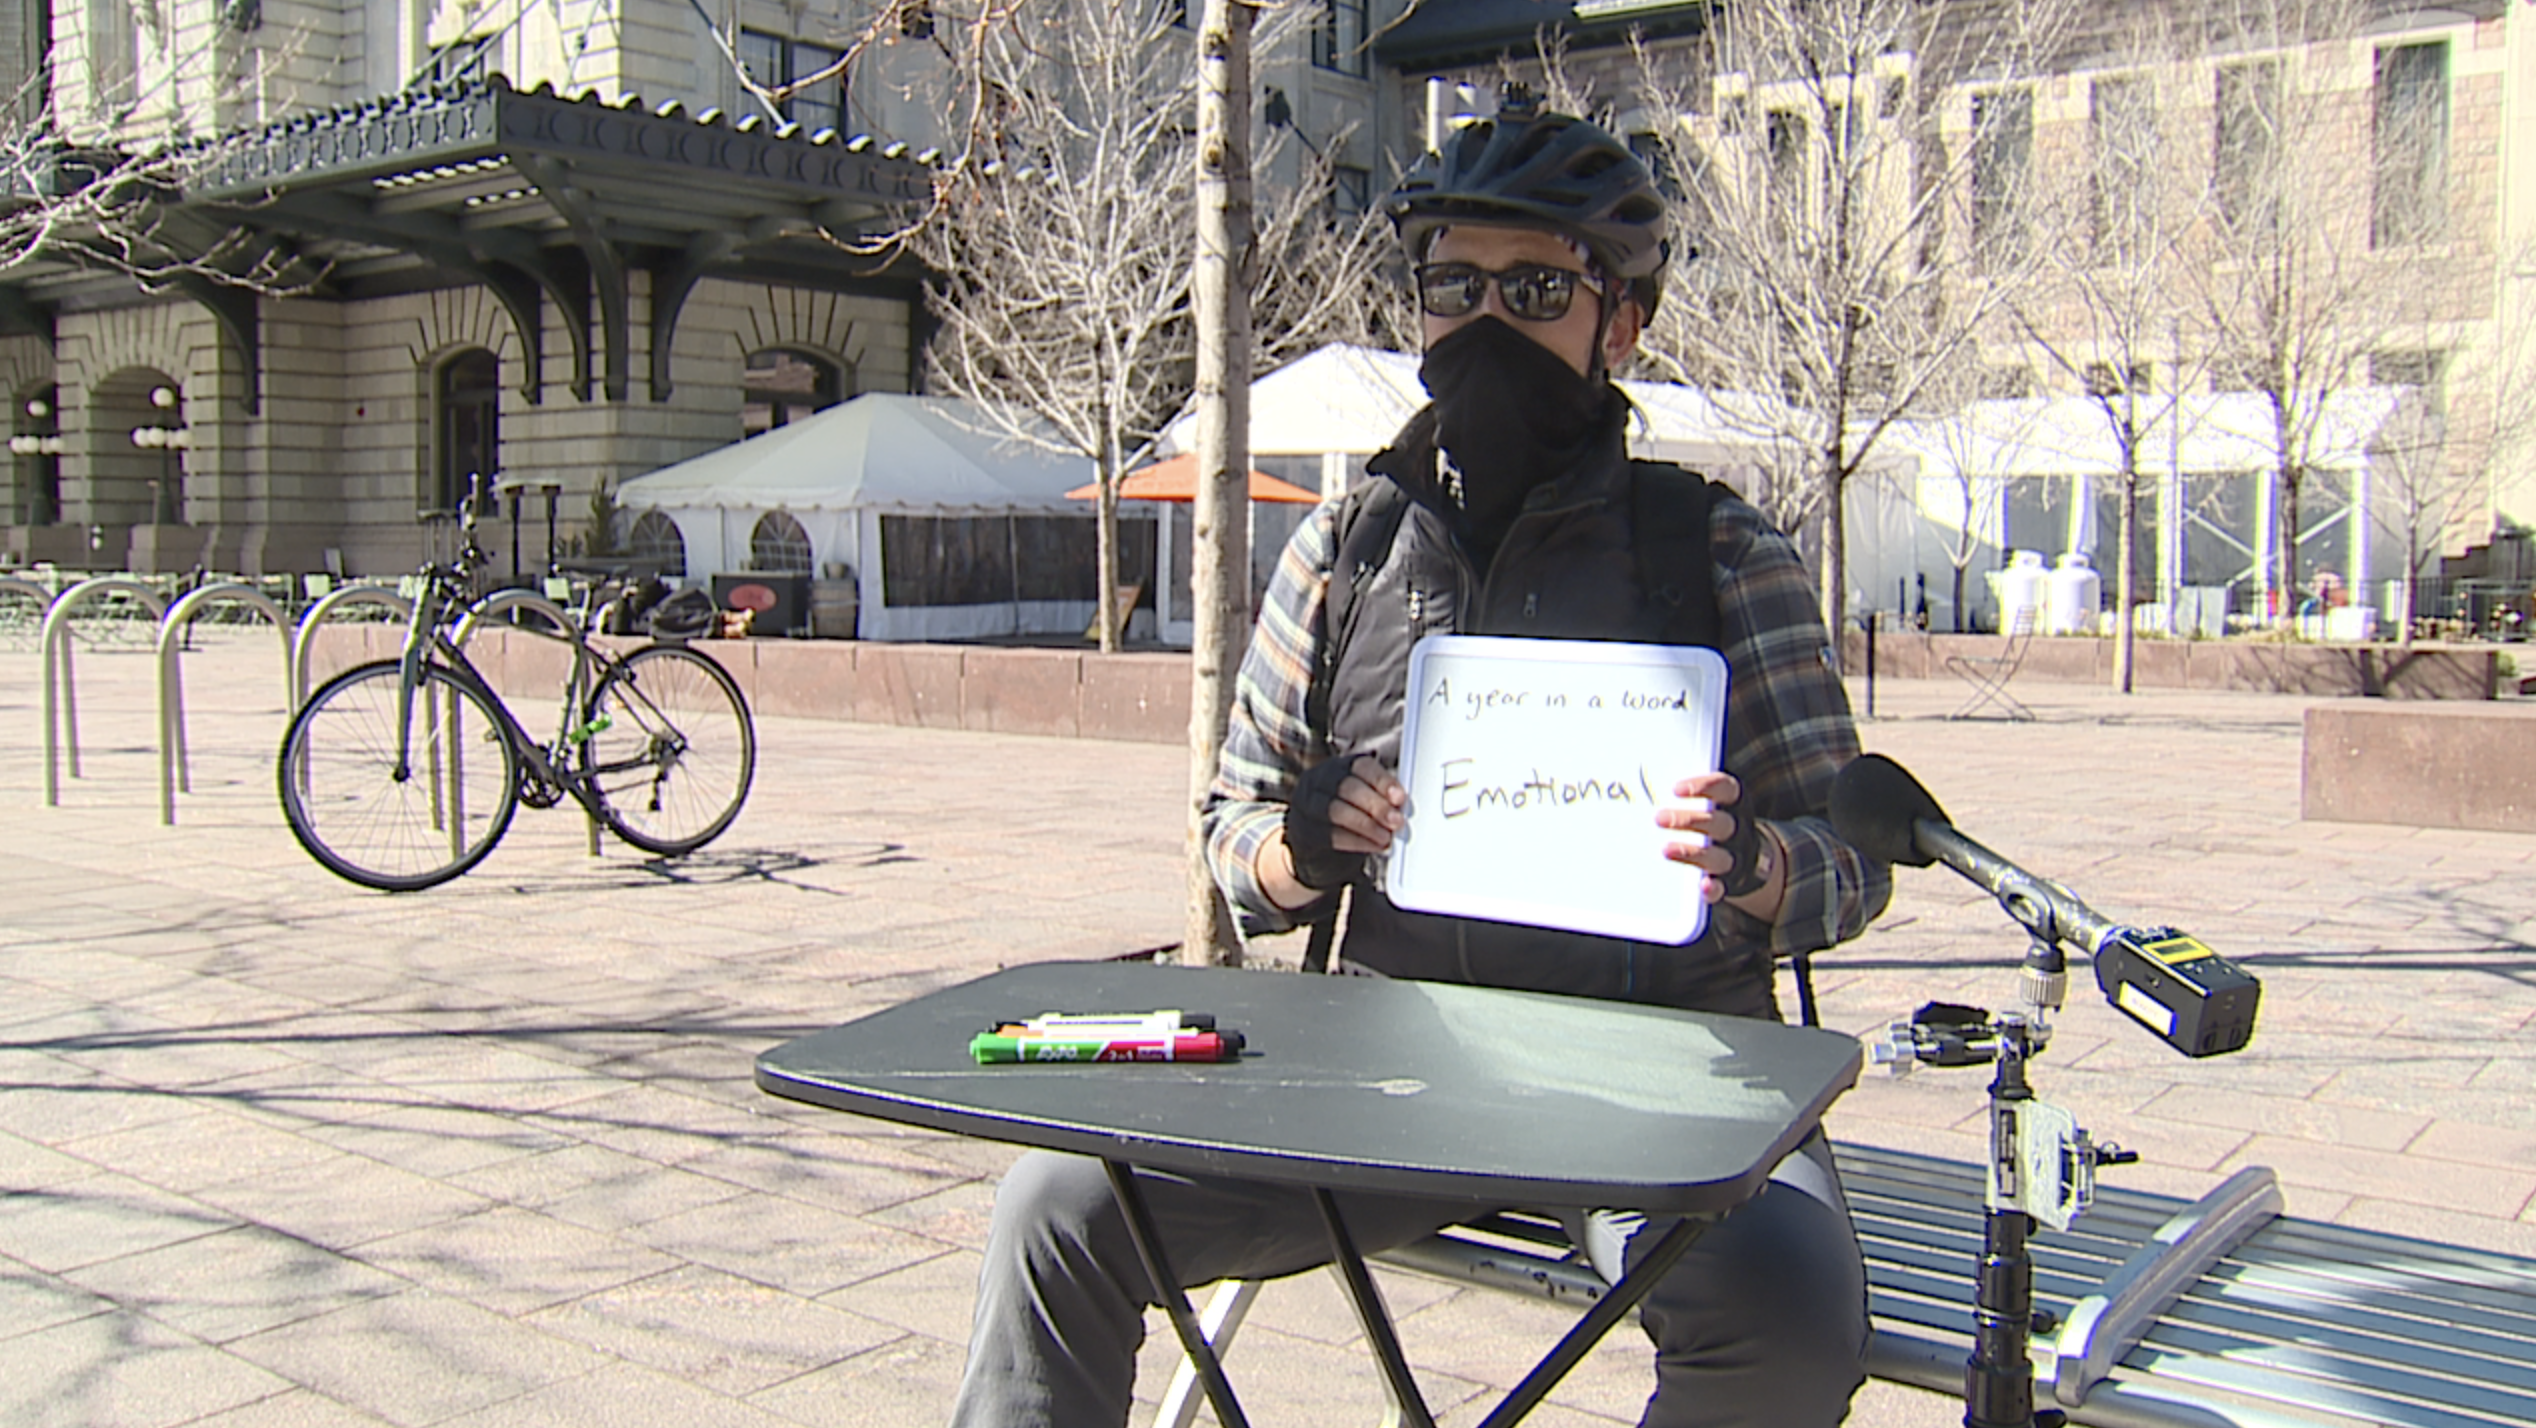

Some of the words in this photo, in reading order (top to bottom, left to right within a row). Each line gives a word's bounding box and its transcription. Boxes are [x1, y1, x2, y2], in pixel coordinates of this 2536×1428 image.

[1428, 677, 1449, 705] A
[1466, 689, 1528, 720] year
[1546, 693, 1567, 708] in
[1587, 694, 1603, 708] a
[1440, 758, 1655, 819] Emotional
